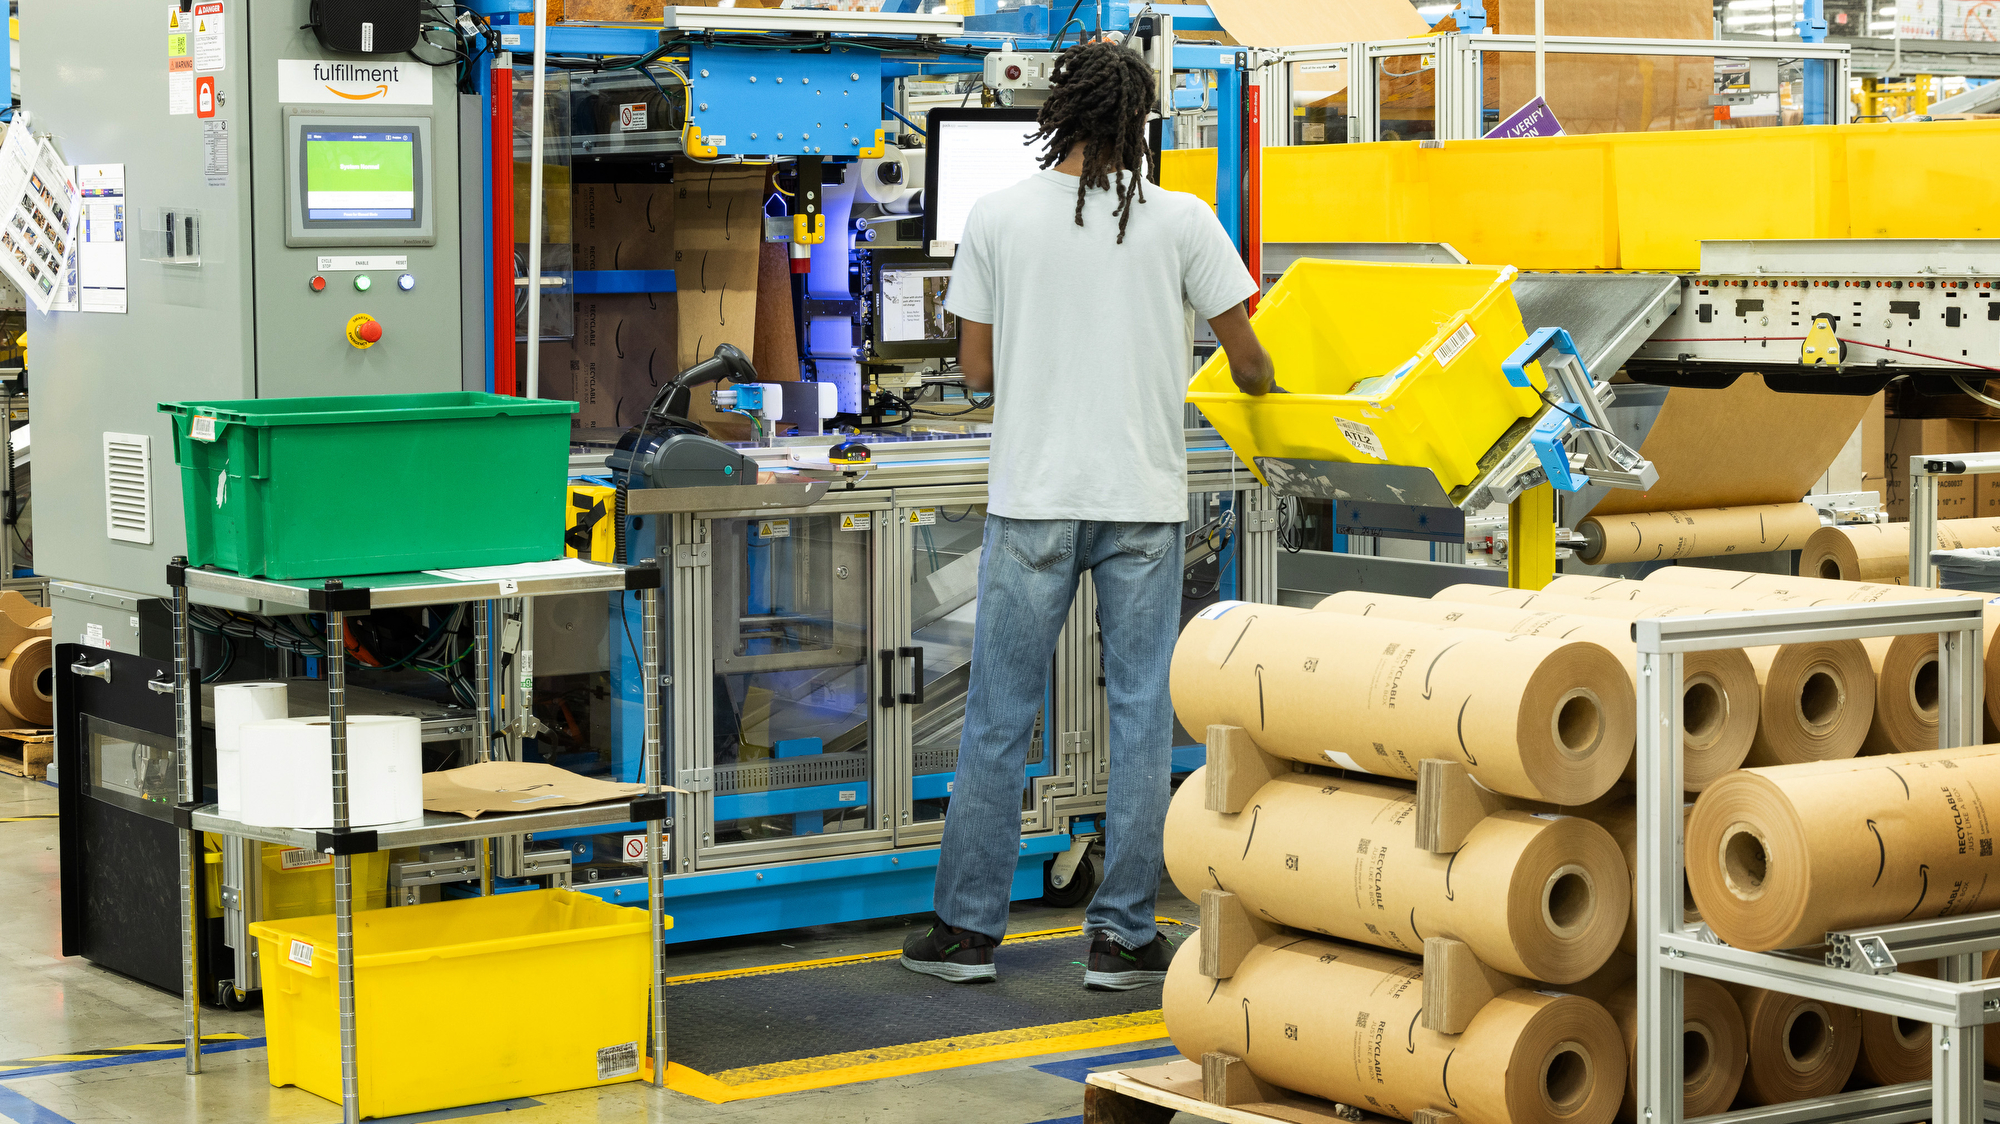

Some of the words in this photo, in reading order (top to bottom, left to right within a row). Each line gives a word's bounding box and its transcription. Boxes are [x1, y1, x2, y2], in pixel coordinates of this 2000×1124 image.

[203, 4, 220, 13] DANGER
[175, 60, 192, 69] WARNING
[314, 64, 399, 82] fulfillment
[1512, 107, 1544, 136] VERIFY
[1523, 127, 1539, 137] ON
[1344, 430, 1372, 445] ATL2
[1389, 649, 1415, 709] RECYCLABLE
[1952, 787, 1963, 803] BOX
[1941, 786, 1966, 854] RECYCLABLE
[1963, 812, 1972, 829] LIKE
[1375, 846, 1388, 910] RECYCLABLE
[1374, 1021, 1386, 1084] RECYCLABLE
